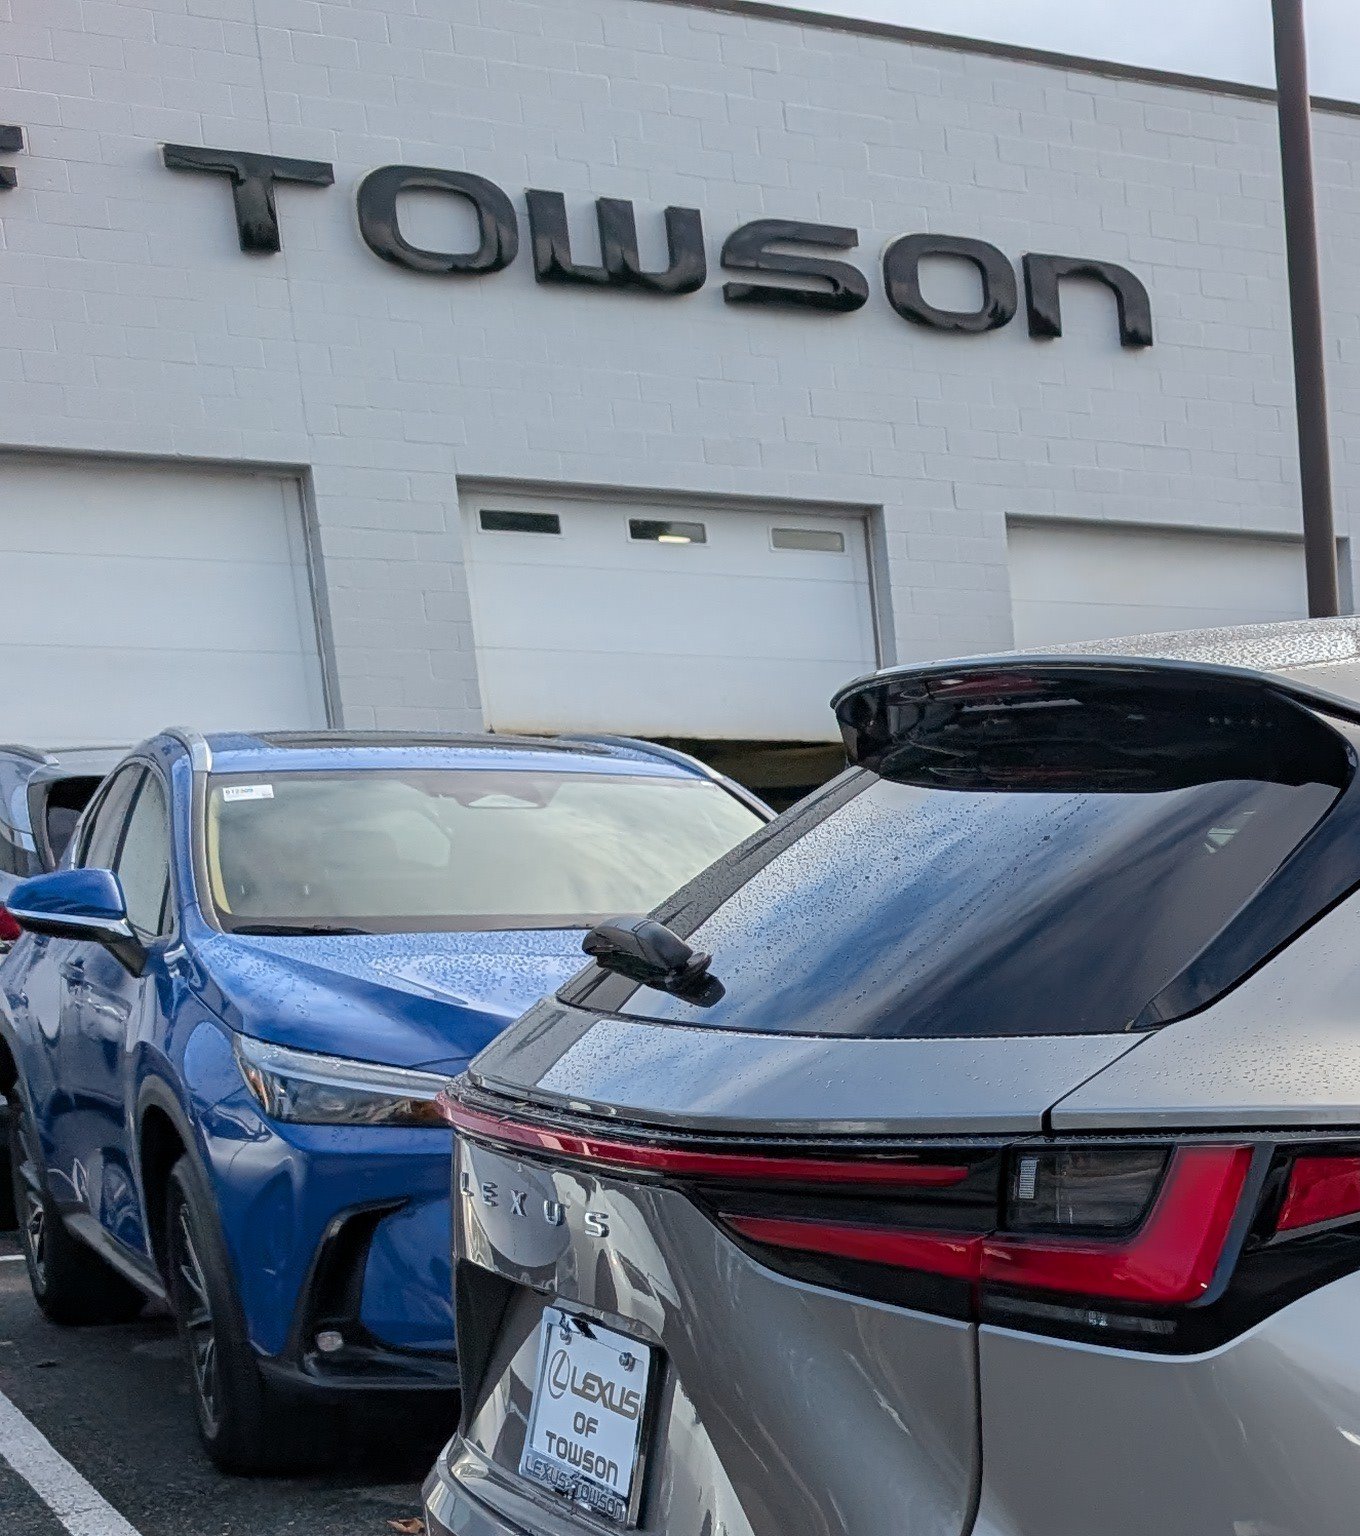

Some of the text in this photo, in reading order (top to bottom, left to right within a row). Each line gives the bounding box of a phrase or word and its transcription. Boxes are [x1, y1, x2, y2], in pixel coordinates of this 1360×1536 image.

[161, 142, 1154, 349] TOWSON
[460, 1171, 610, 1238] LEXUS
[570, 1365, 641, 1421] LEXUS
[573, 1411, 600, 1438] OF
[525, 1455, 567, 1490] LEXUS
[545, 1429, 620, 1487] TOWSON
